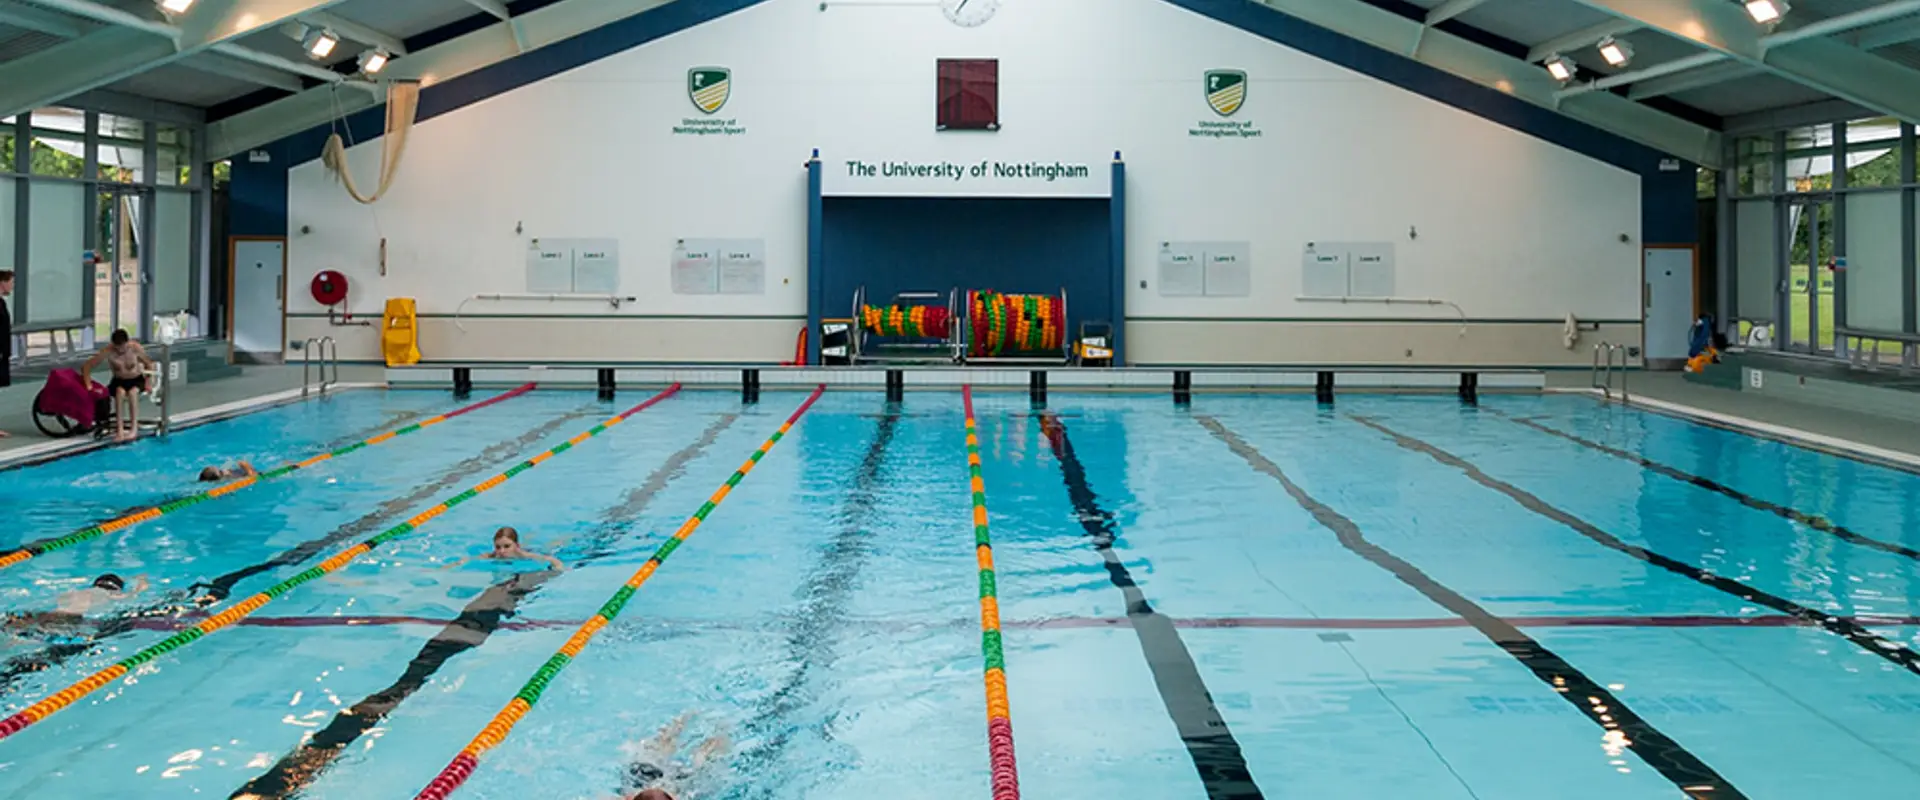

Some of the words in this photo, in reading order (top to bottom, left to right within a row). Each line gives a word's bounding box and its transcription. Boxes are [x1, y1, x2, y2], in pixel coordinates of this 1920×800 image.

[727, 118, 737, 126] of
[1198, 120, 1241, 129] University
[1242, 120, 1252, 128] of
[672, 126, 722, 135] Nottingham
[723, 126, 747, 135] Sport
[1188, 129, 1238, 138] Nottingham
[1239, 129, 1262, 138] Sport
[846, 161, 877, 178] The
[882, 161, 965, 181] University
[969, 160, 988, 178] of
[993, 161, 1089, 182] Nottingham
